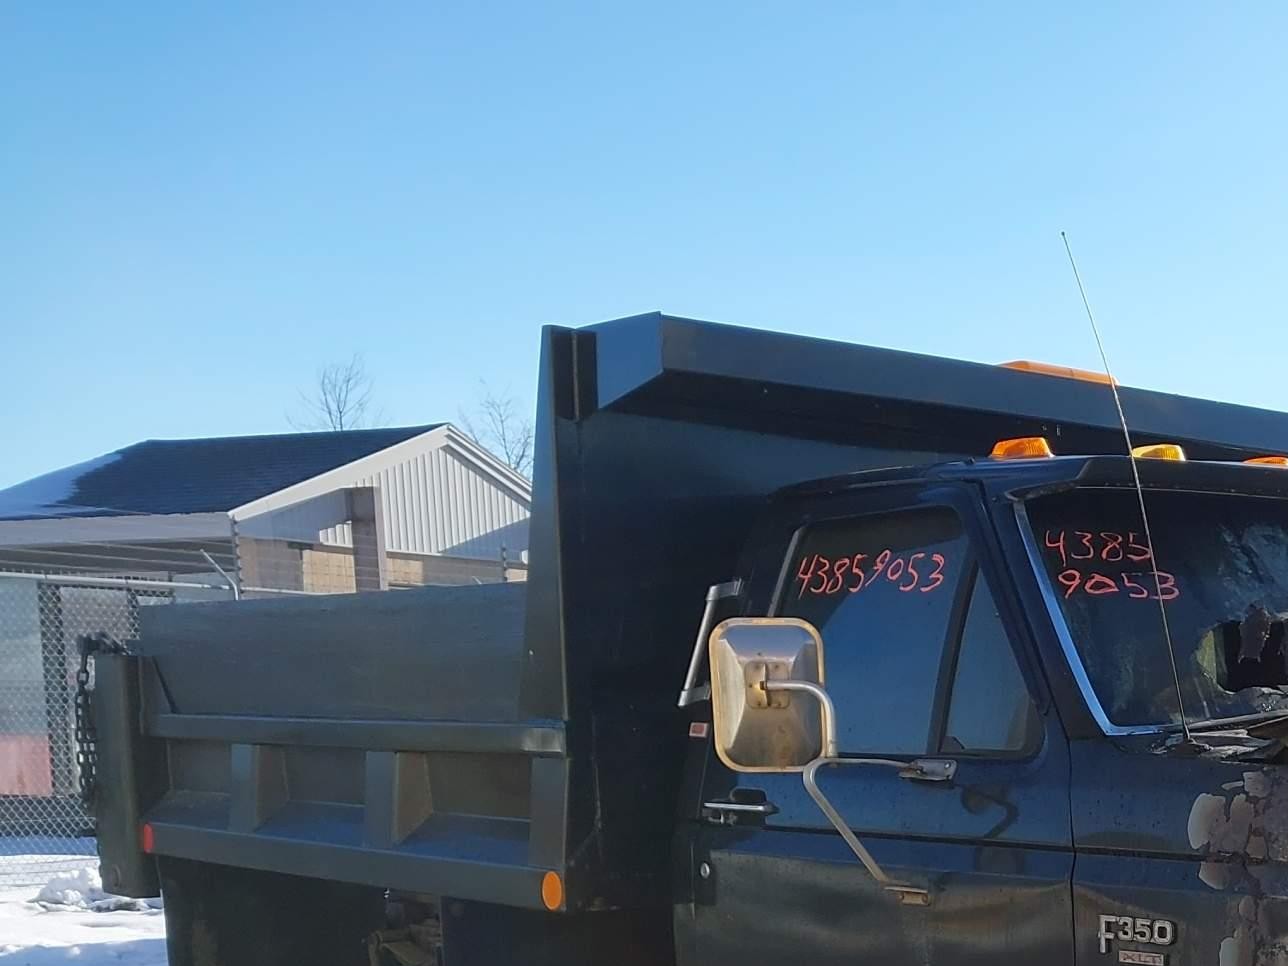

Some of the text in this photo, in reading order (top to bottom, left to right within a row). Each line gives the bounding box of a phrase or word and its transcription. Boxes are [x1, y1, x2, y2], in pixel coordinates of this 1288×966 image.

[1046, 529, 1151, 566] 4385
[797, 549, 945, 599] 43859053
[1058, 568, 1180, 600] 9053
[1098, 915, 1173, 953] F350
